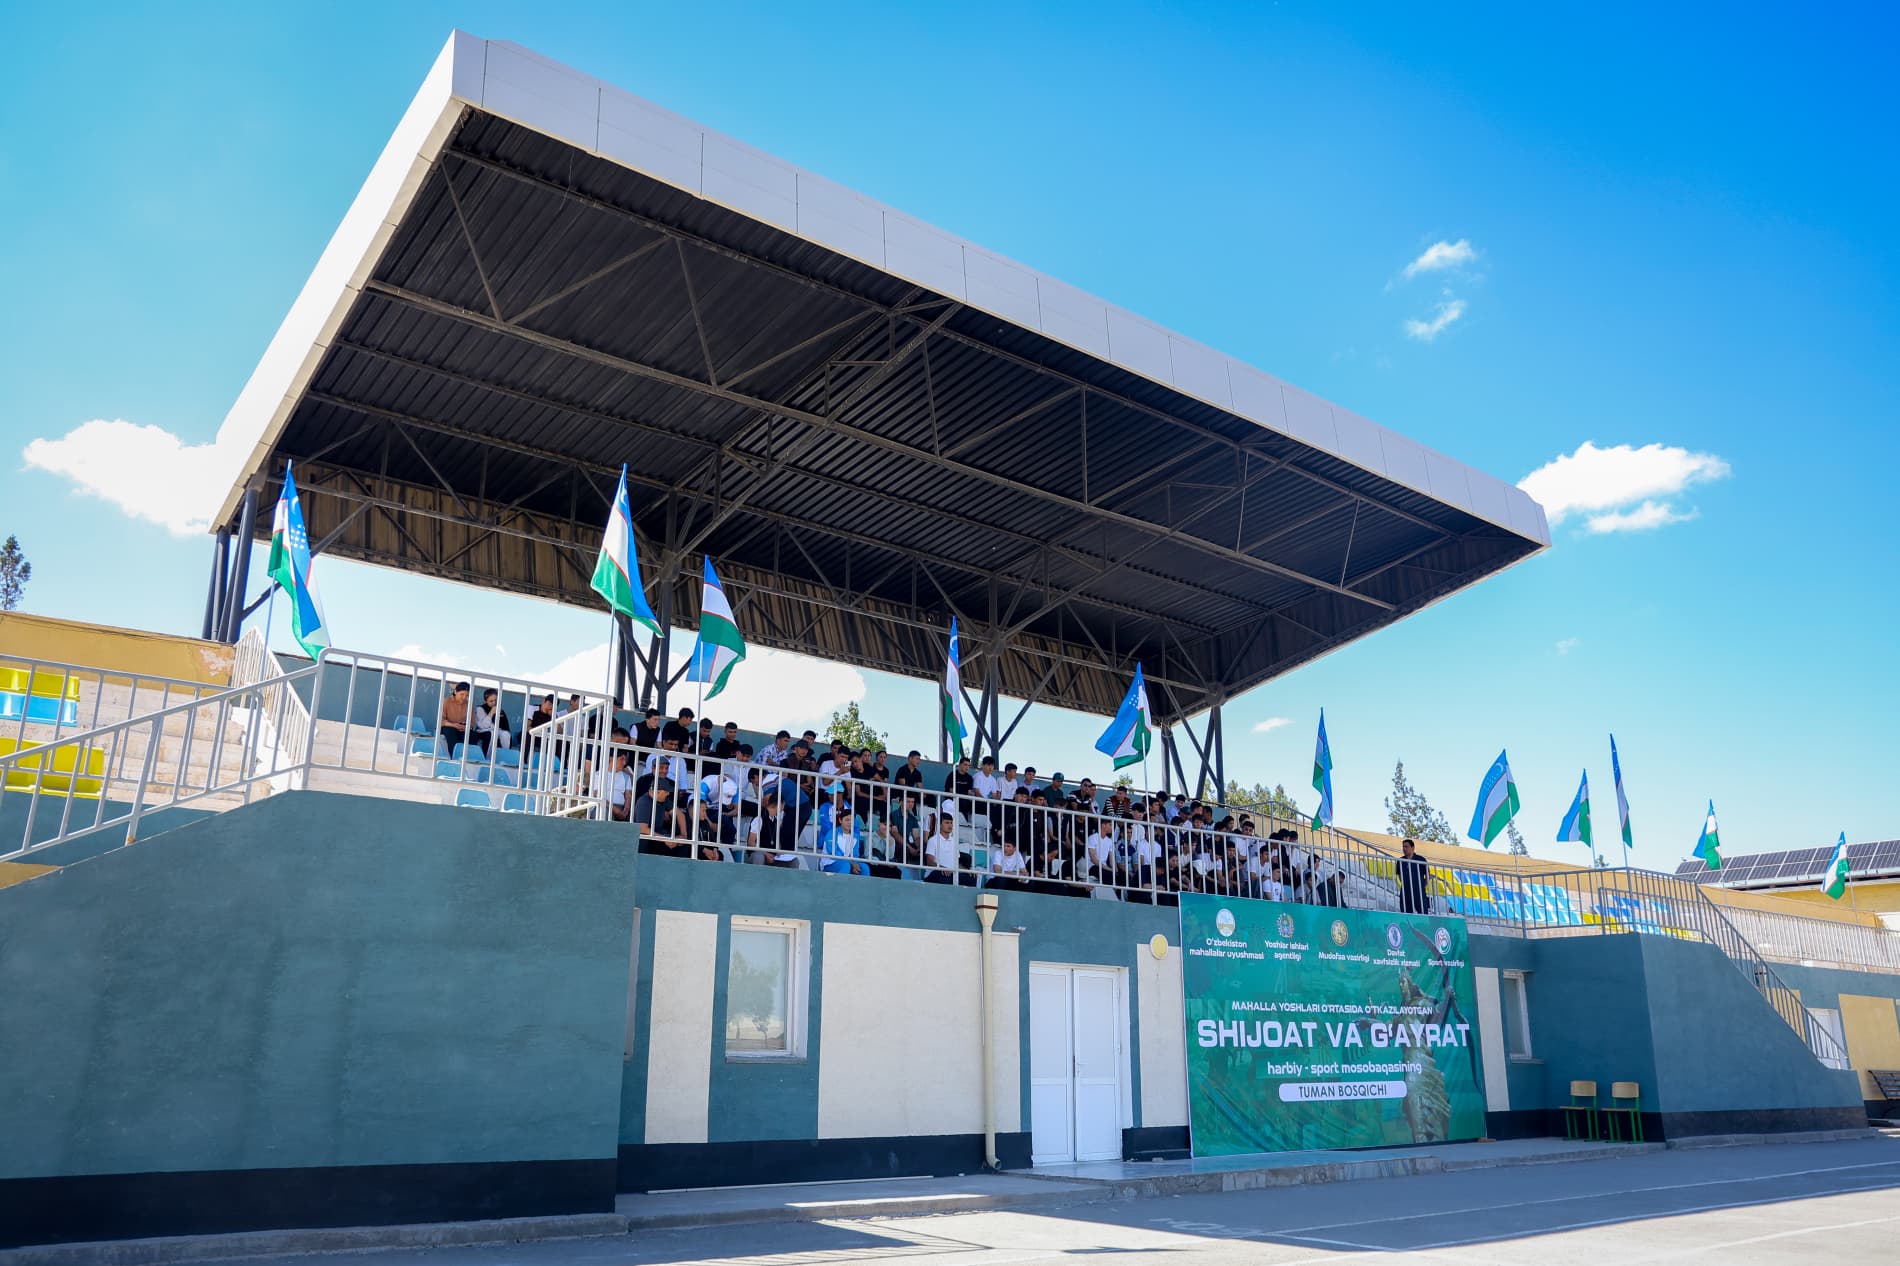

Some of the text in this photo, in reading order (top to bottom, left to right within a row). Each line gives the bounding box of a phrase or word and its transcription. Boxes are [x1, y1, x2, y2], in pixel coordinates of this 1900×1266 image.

[1265, 940, 1288, 949] Yoshlar
[1189, 948, 1264, 961] mahallalar uyushmasi
[1232, 1001, 1277, 1011] MAHALLA
[1278, 1003, 1320, 1013] YOSHLARI
[1198, 1020, 1317, 1048] SHIJOAT
[1325, 1022, 1364, 1048] VA
[1267, 1062, 1302, 1077] harbiy
[1311, 1062, 1339, 1077] sport
[1341, 1061, 1422, 1076] mosobaqasining
[1298, 1084, 1387, 1098] TUMAN BOSQICHI
